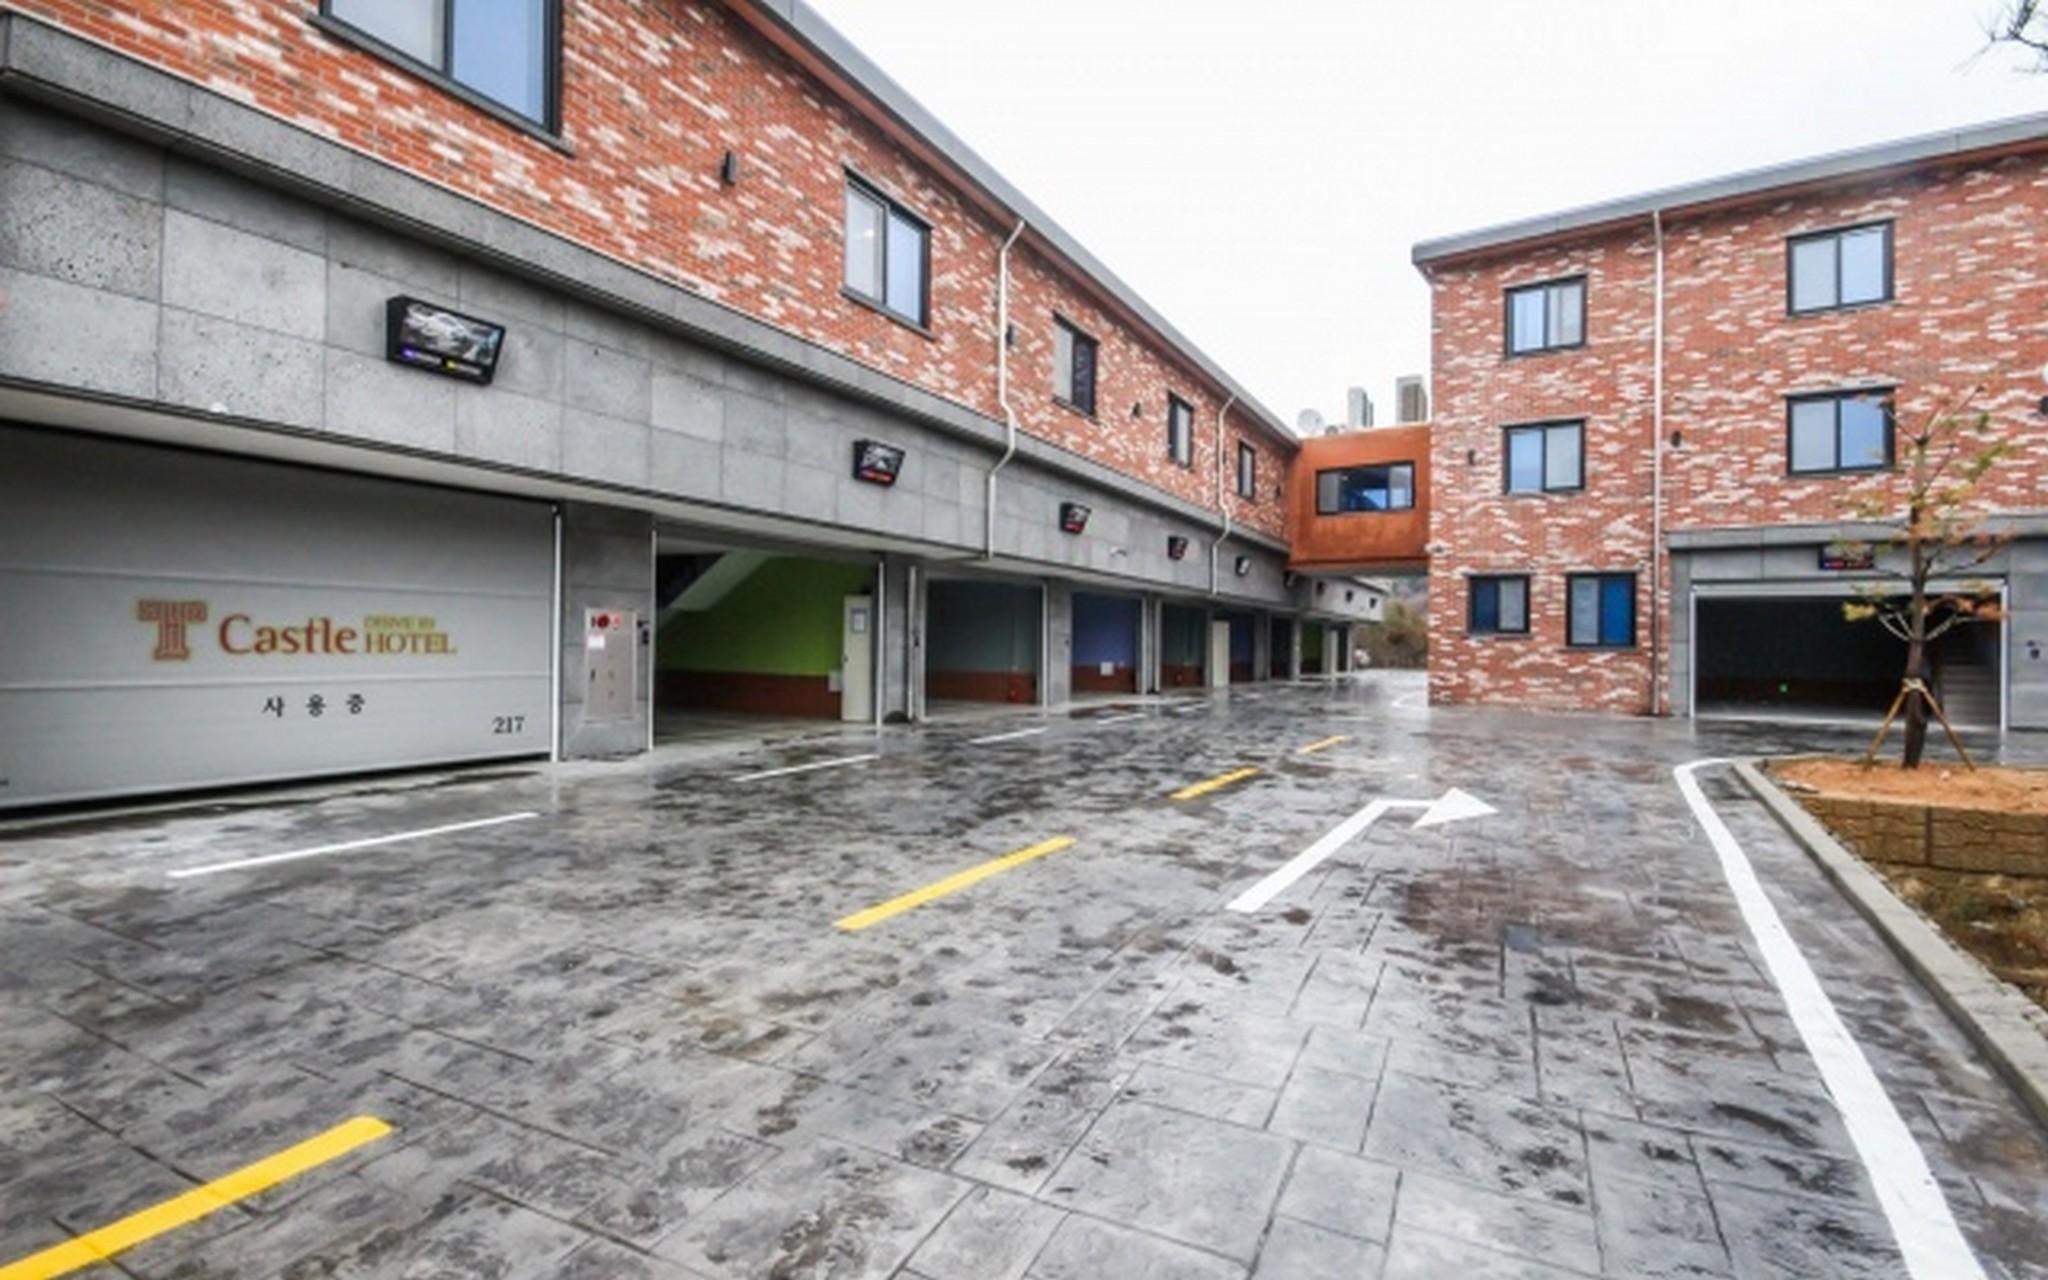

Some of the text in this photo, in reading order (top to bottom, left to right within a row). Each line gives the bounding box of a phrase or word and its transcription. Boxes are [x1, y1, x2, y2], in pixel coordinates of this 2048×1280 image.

[218, 614, 358, 656] Castle
[364, 631, 458, 655] HOTEL
[492, 715, 525, 735] 217
